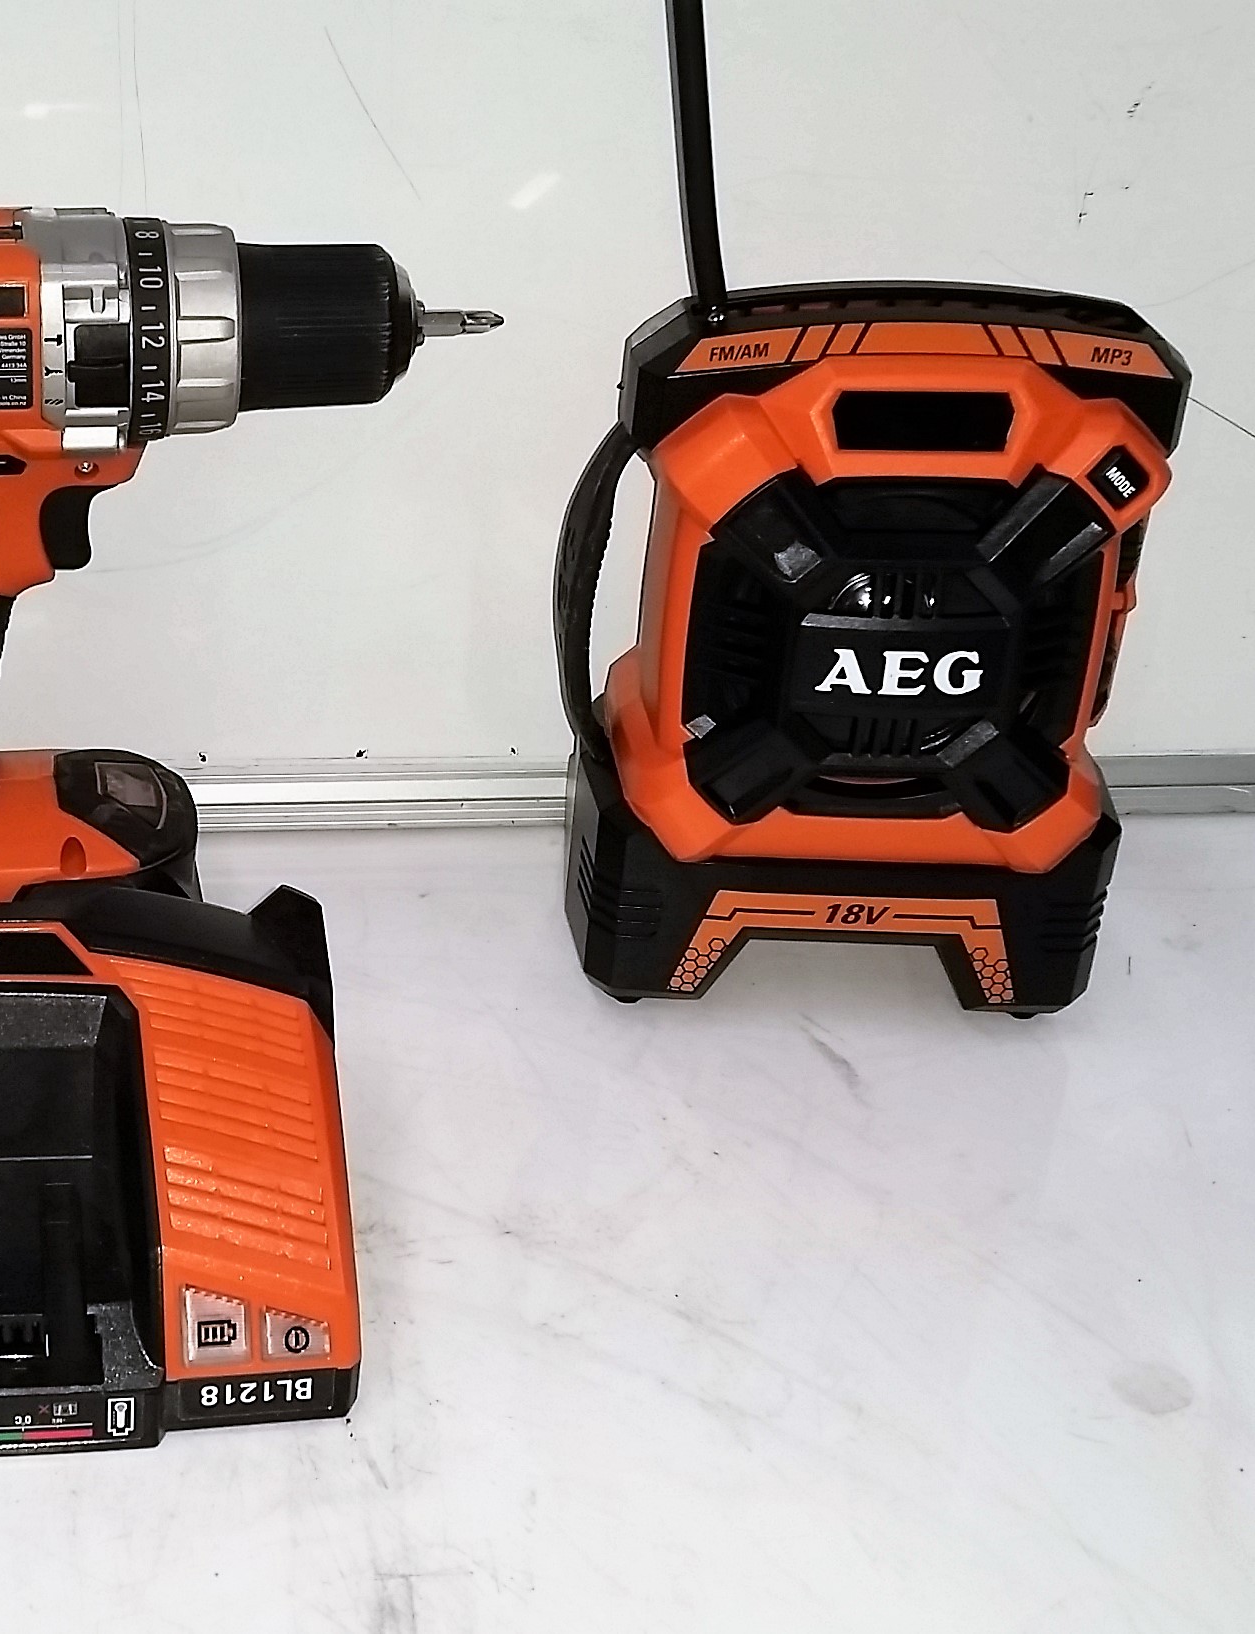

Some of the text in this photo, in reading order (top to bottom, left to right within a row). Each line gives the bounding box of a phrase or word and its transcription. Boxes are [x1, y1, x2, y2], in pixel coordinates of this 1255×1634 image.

[135, 230, 160, 240] 8
[138, 265, 164, 289] 10
[141, 322, 166, 350] 12
[708, 342, 770, 362] FM/AM
[1090, 345, 1134, 367] MP3
[141, 380, 166, 403] 14
[138, 422, 163, 436] 16
[1103, 465, 1137, 499] MODE
[814, 648, 984, 695] AEG
[825, 903, 891, 925] 18V
[201, 1377, 313, 1406] BL1218
